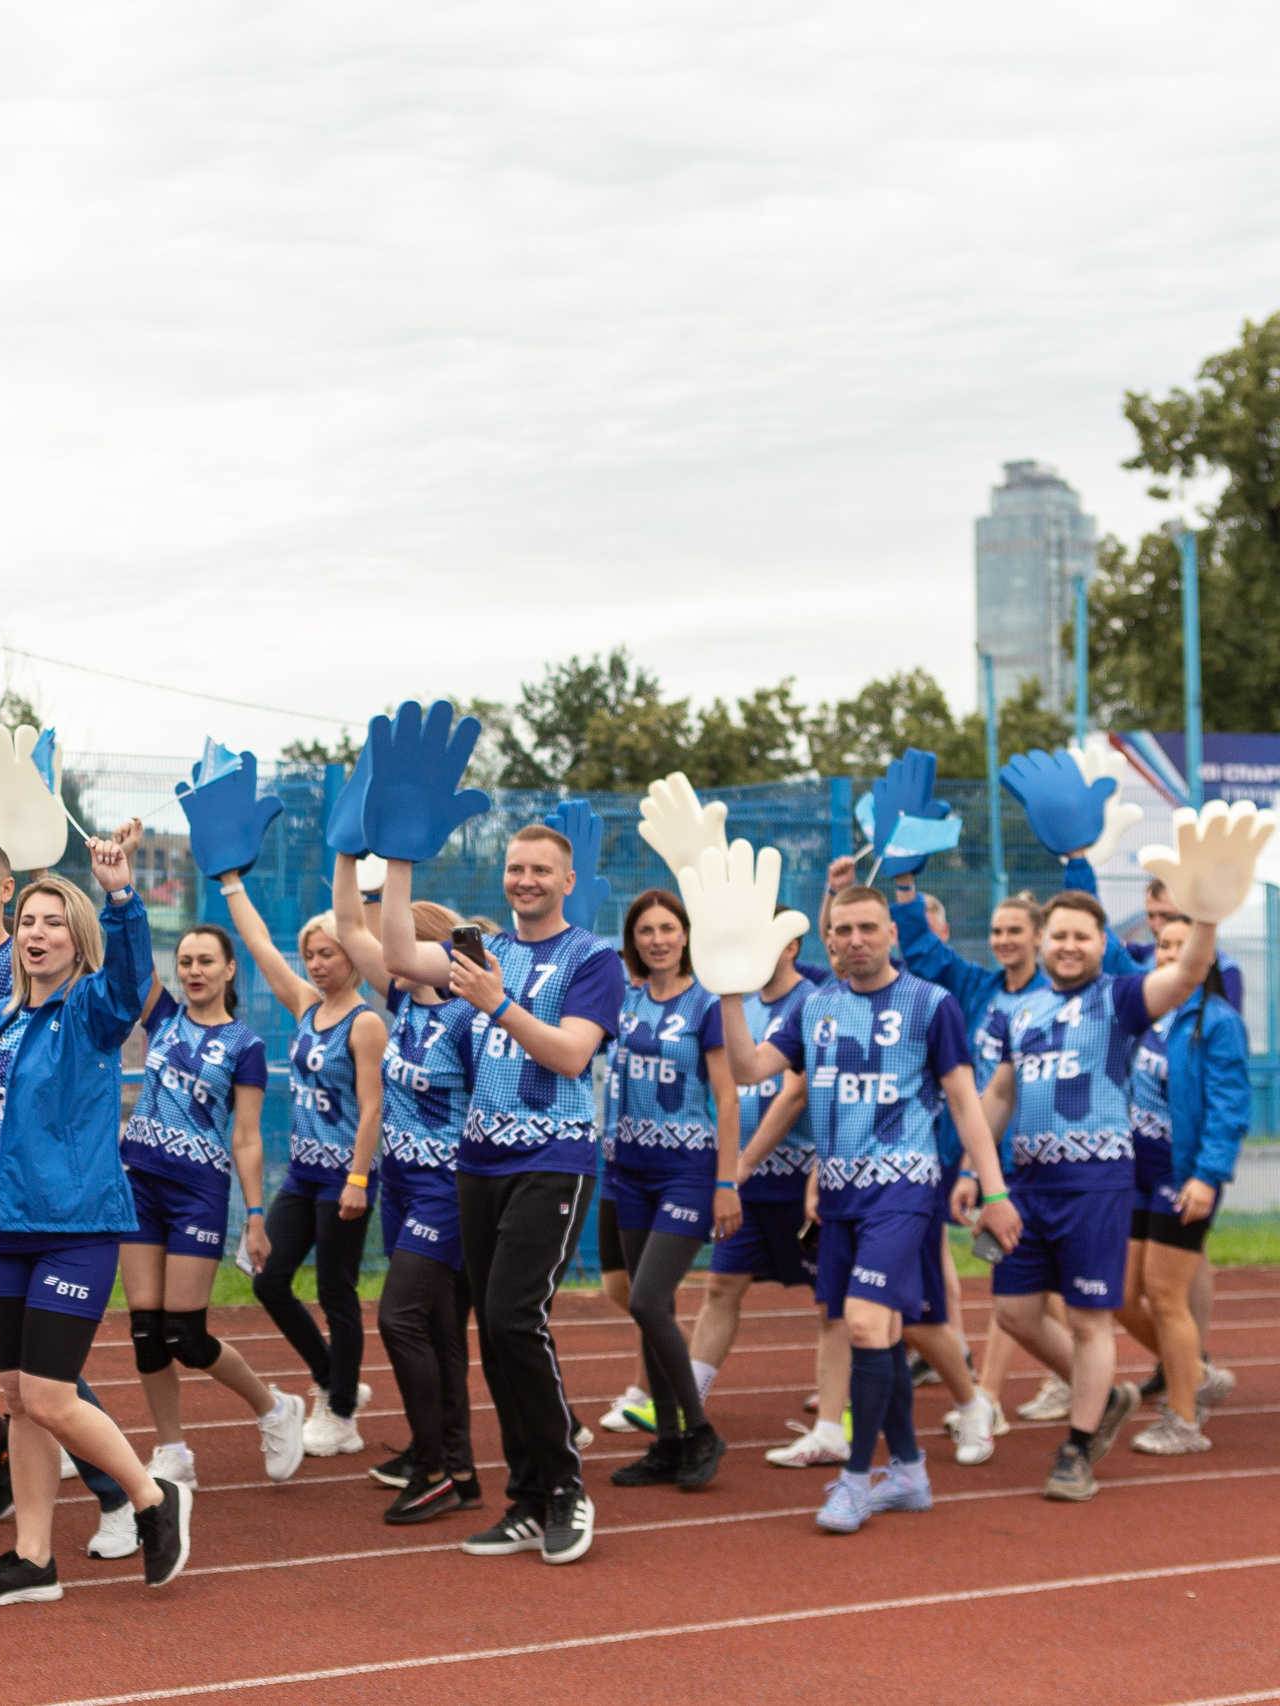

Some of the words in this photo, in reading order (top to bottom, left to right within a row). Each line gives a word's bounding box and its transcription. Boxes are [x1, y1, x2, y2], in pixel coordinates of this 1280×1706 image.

[527, 964, 558, 998] 7
[1056, 995, 1084, 1028] 4
[423, 1020, 447, 1048] 7
[658, 1013, 686, 1042] 2
[874, 1010, 903, 1046] 3
[201, 1040, 226, 1065] 3
[306, 1045, 327, 1072] 6
[1022, 1050, 1080, 1082] ВТБ
[388, 1055, 430, 1091] ВТБ
[629, 1054, 677, 1084] ВТБ
[162, 1065, 211, 1104] ВТБ
[838, 1073, 900, 1104] ВТБ
[671, 1206, 699, 1222] ВТБ
[197, 1230, 220, 1244] ВТБ
[412, 1223, 440, 1241] ВТБ
[56, 1281, 90, 1299] ВТБ
[858, 1269, 887, 1287] ВТБ
